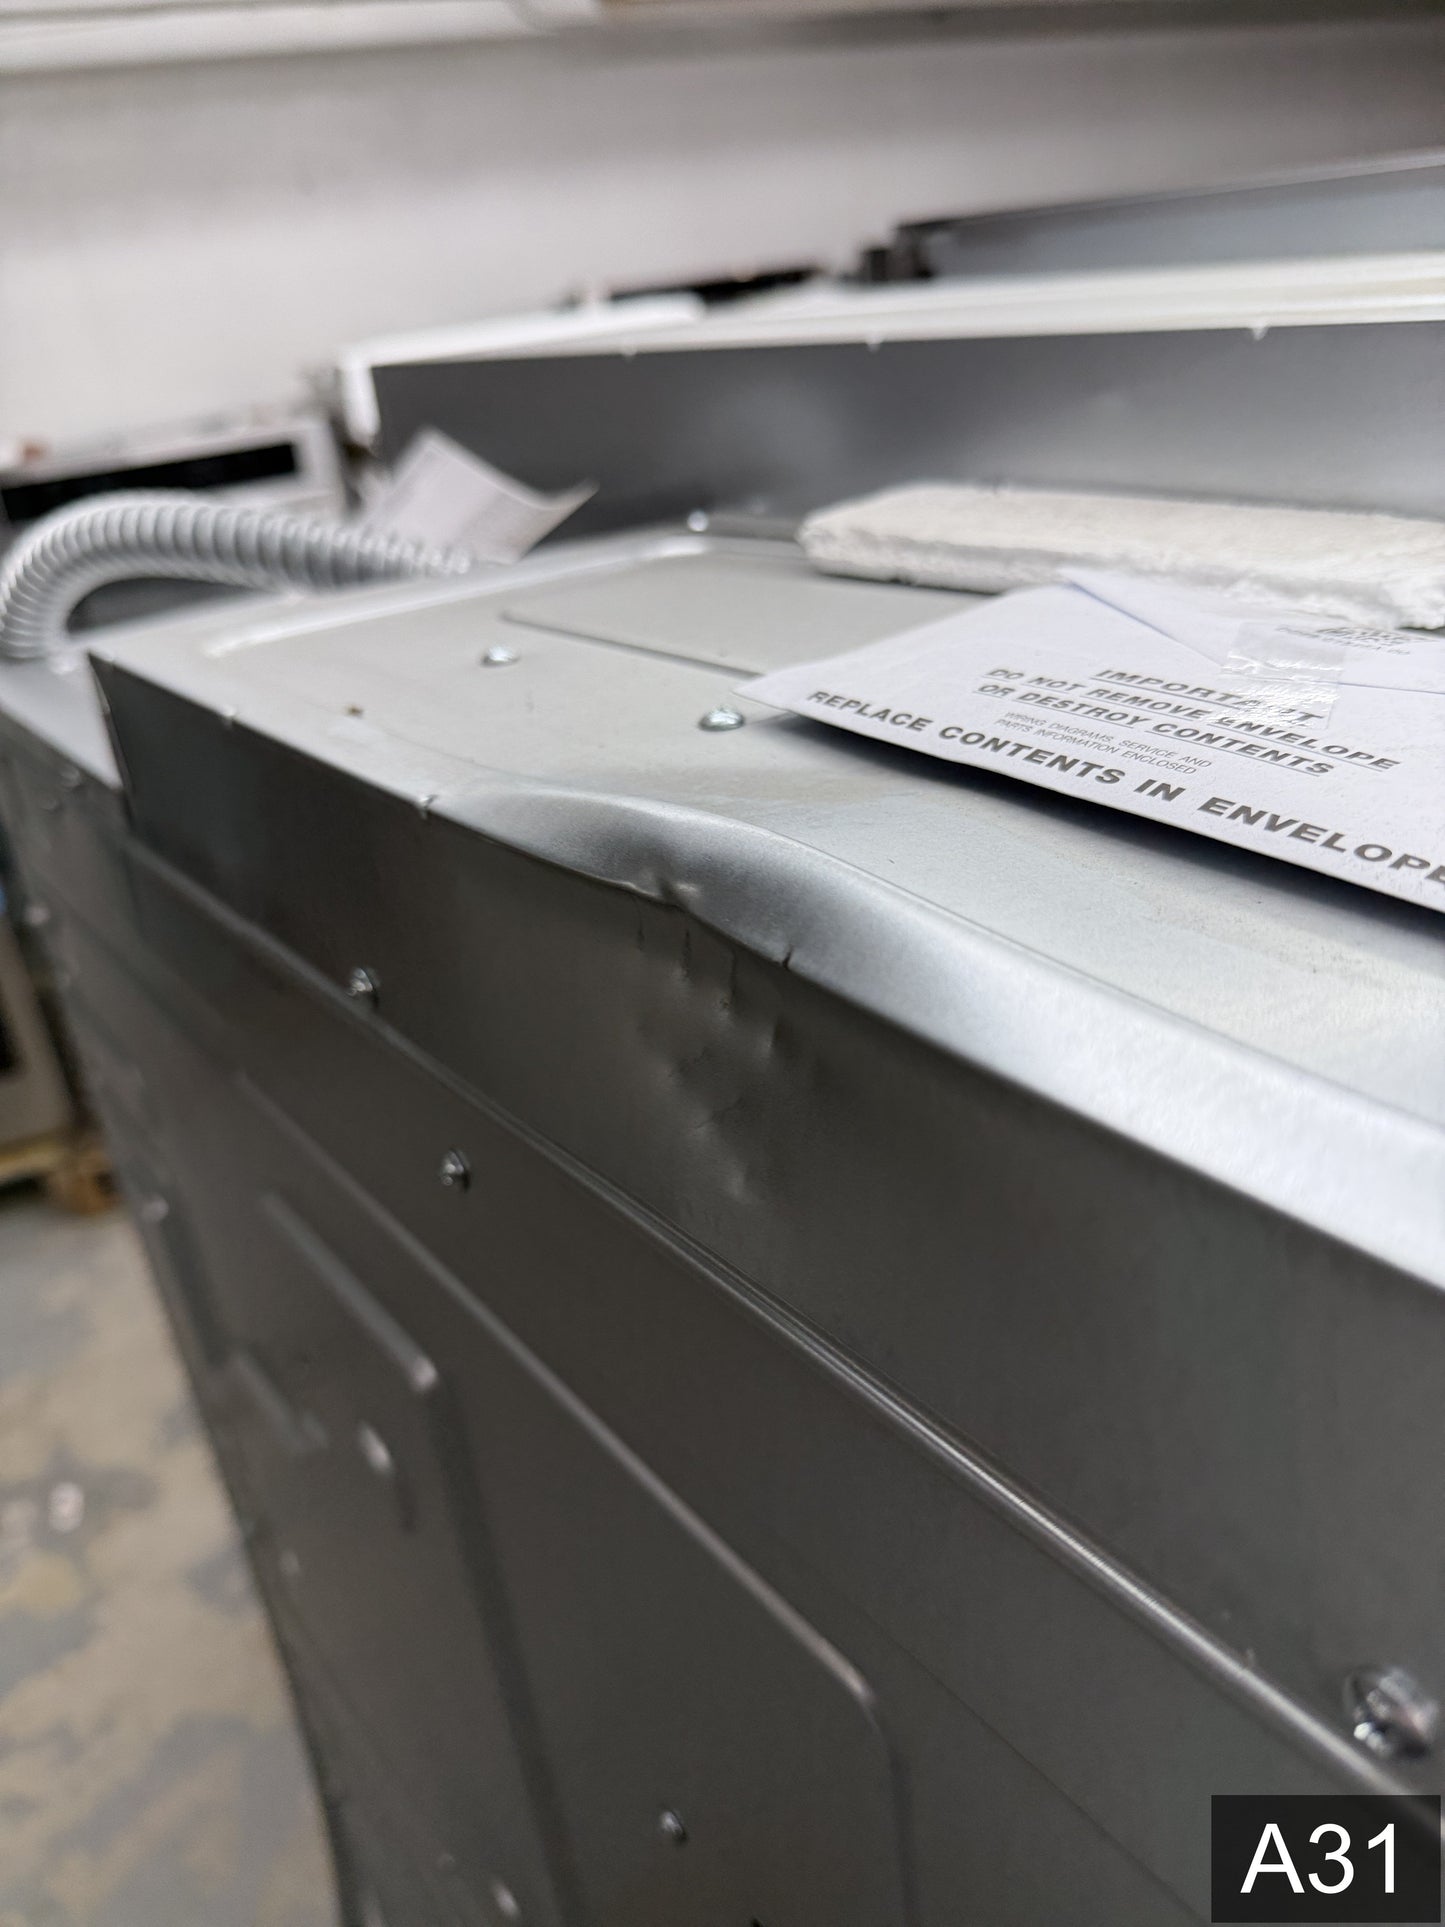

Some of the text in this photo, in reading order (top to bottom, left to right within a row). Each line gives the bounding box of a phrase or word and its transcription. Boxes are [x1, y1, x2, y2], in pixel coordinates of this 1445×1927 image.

[978, 684, 1335, 775] OR DESTROY CONTENTS
[988, 669, 1401, 770] DO NOT REMOVE ENVELOPE
[1096, 670, 1324, 723] IMPORTAT
[807, 691, 934, 732] REPLACE
[938, 726, 1126, 785] CONTENTS
[1133, 779, 1186, 802] IN
[995, 718, 1198, 775] PARTS INFORMATION ENCLOSED
[1005, 712, 1047, 727] WIRING
[1118, 739, 1178, 759] SERVICE
[1179, 756, 1213, 768] AND
